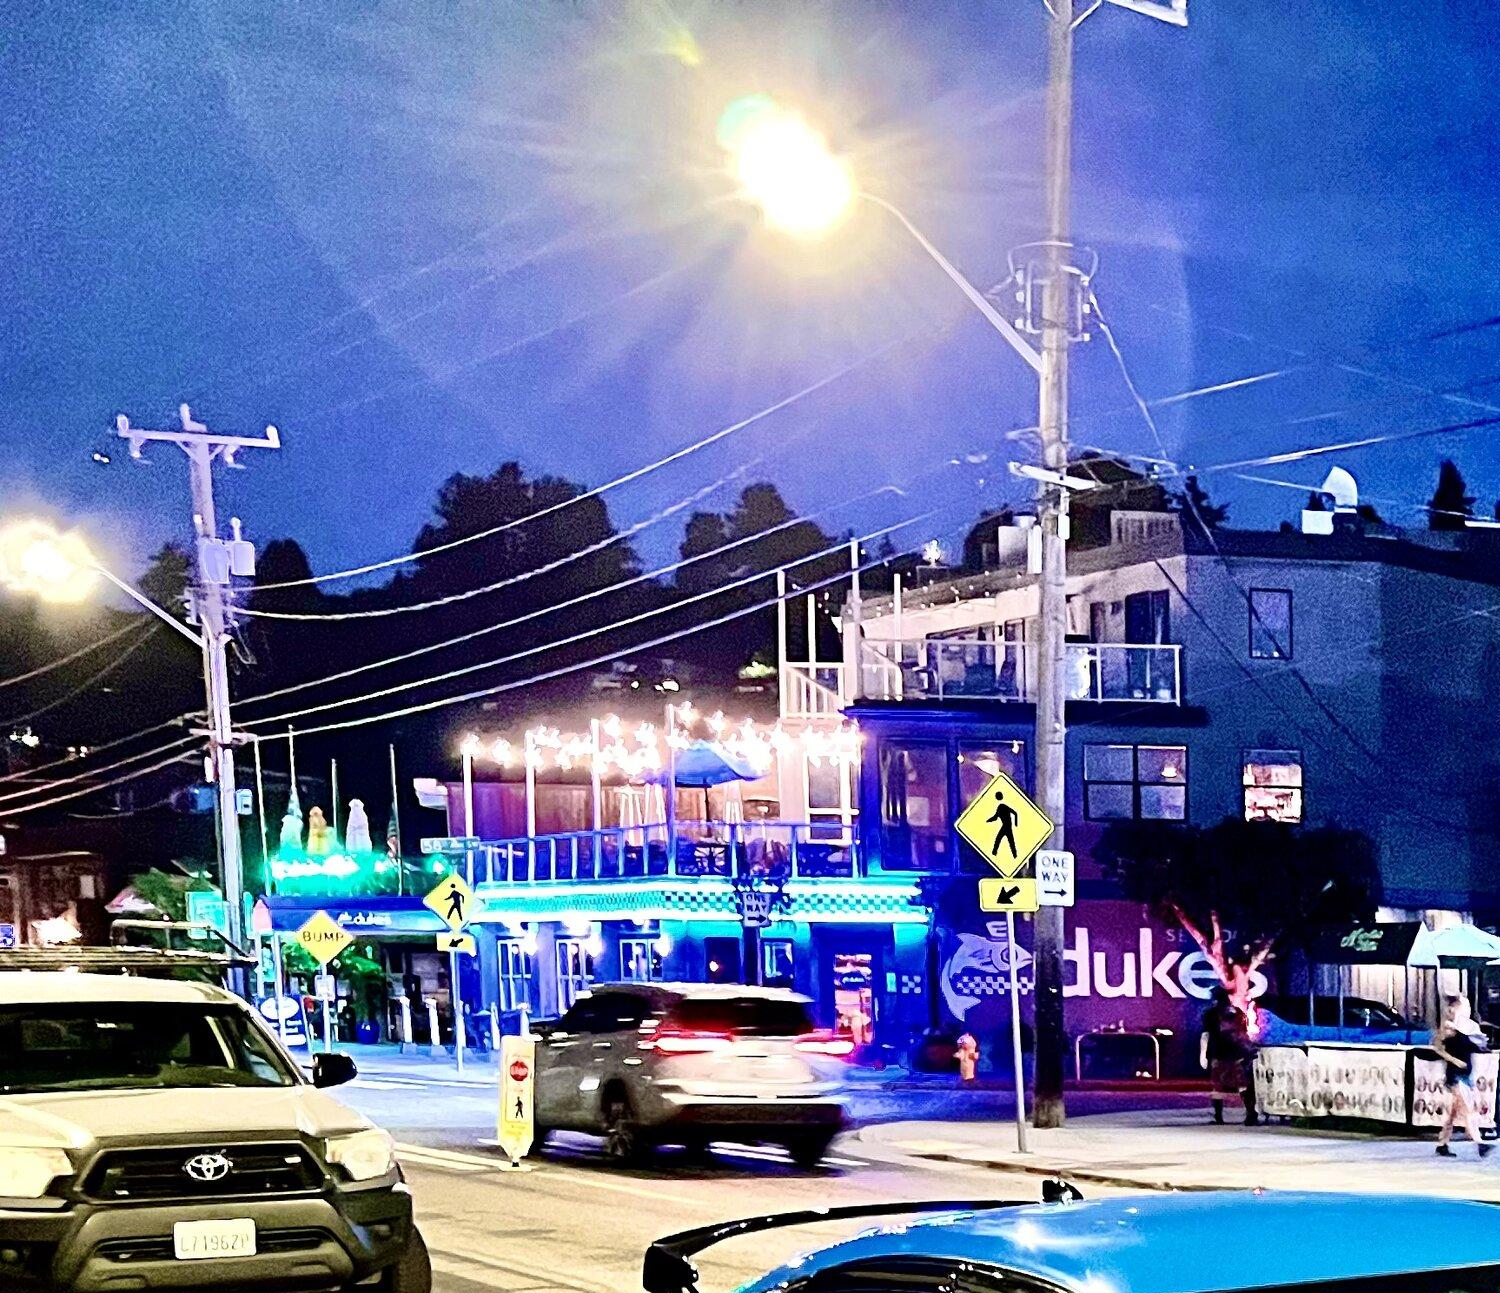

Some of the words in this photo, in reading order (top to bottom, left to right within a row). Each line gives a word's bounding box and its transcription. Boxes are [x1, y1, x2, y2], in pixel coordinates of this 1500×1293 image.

[1042, 856, 1068, 869] ONE
[1042, 872, 1069, 883] WAY
[303, 931, 344, 942] BUMP
